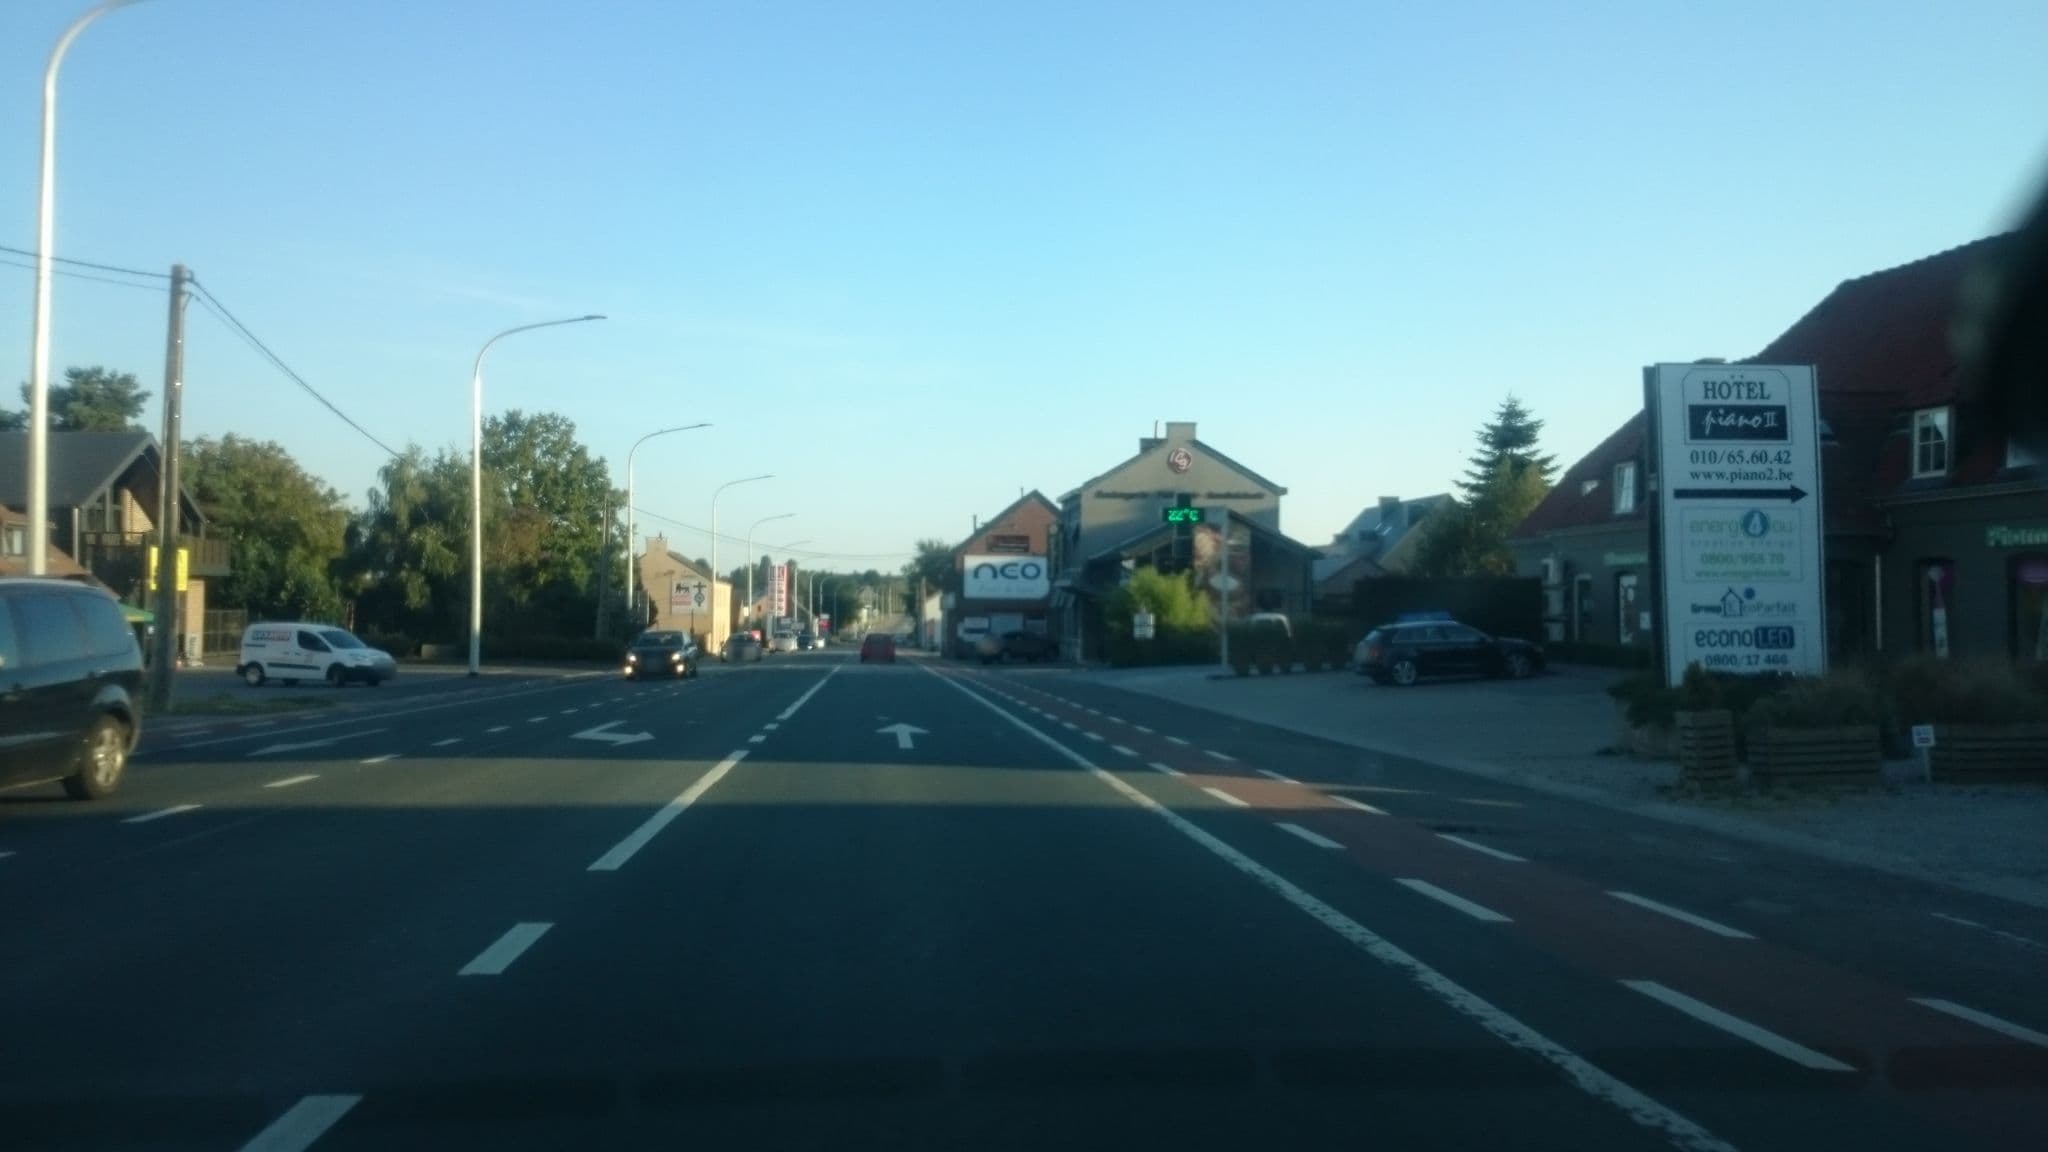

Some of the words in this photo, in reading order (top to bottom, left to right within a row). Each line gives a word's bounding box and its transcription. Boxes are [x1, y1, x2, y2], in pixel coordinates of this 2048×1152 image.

[1703, 381, 1770, 400] HOTEL
[1702, 408, 1762, 436] piano
[1690, 450, 1792, 465] 010/65.60.42
[1690, 469, 1793, 483] www.piano2.be
